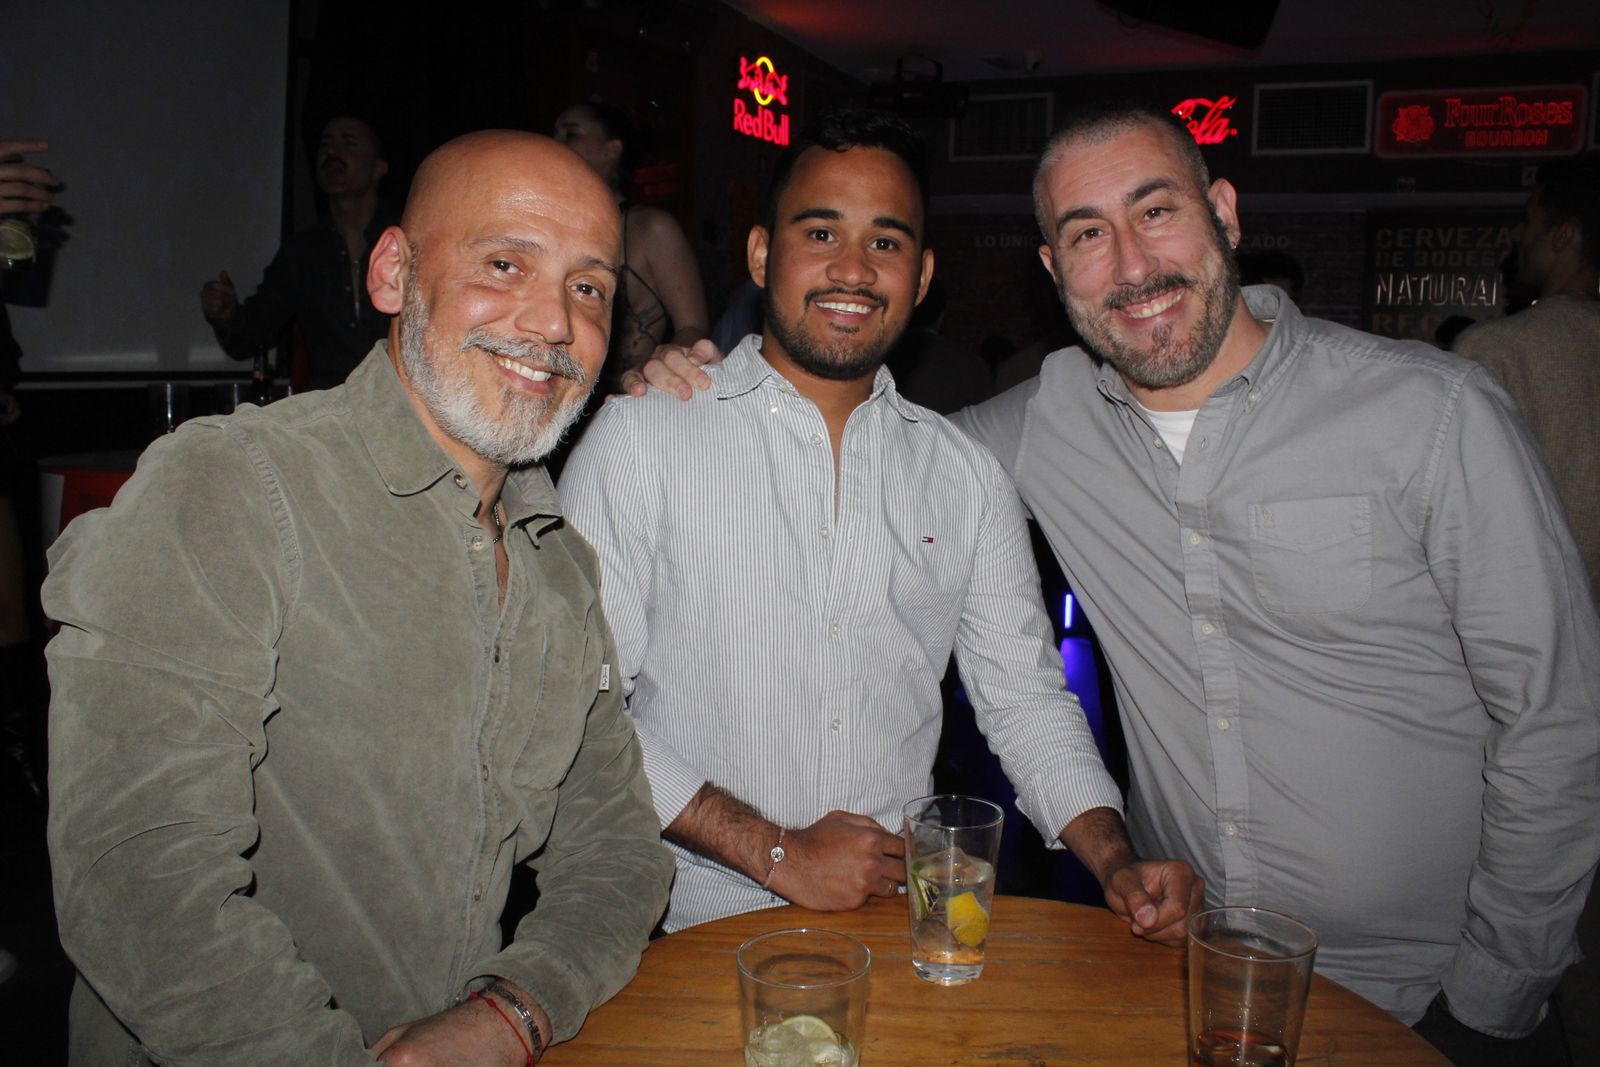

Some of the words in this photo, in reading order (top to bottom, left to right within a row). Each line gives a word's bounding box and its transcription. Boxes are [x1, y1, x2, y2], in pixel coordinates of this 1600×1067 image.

[1464, 129, 1549, 147] BOURBON
[999, 231, 1039, 249] ÚNIC
[1375, 226, 1512, 249] CERVEZA
[1375, 250, 1405, 268] DE
